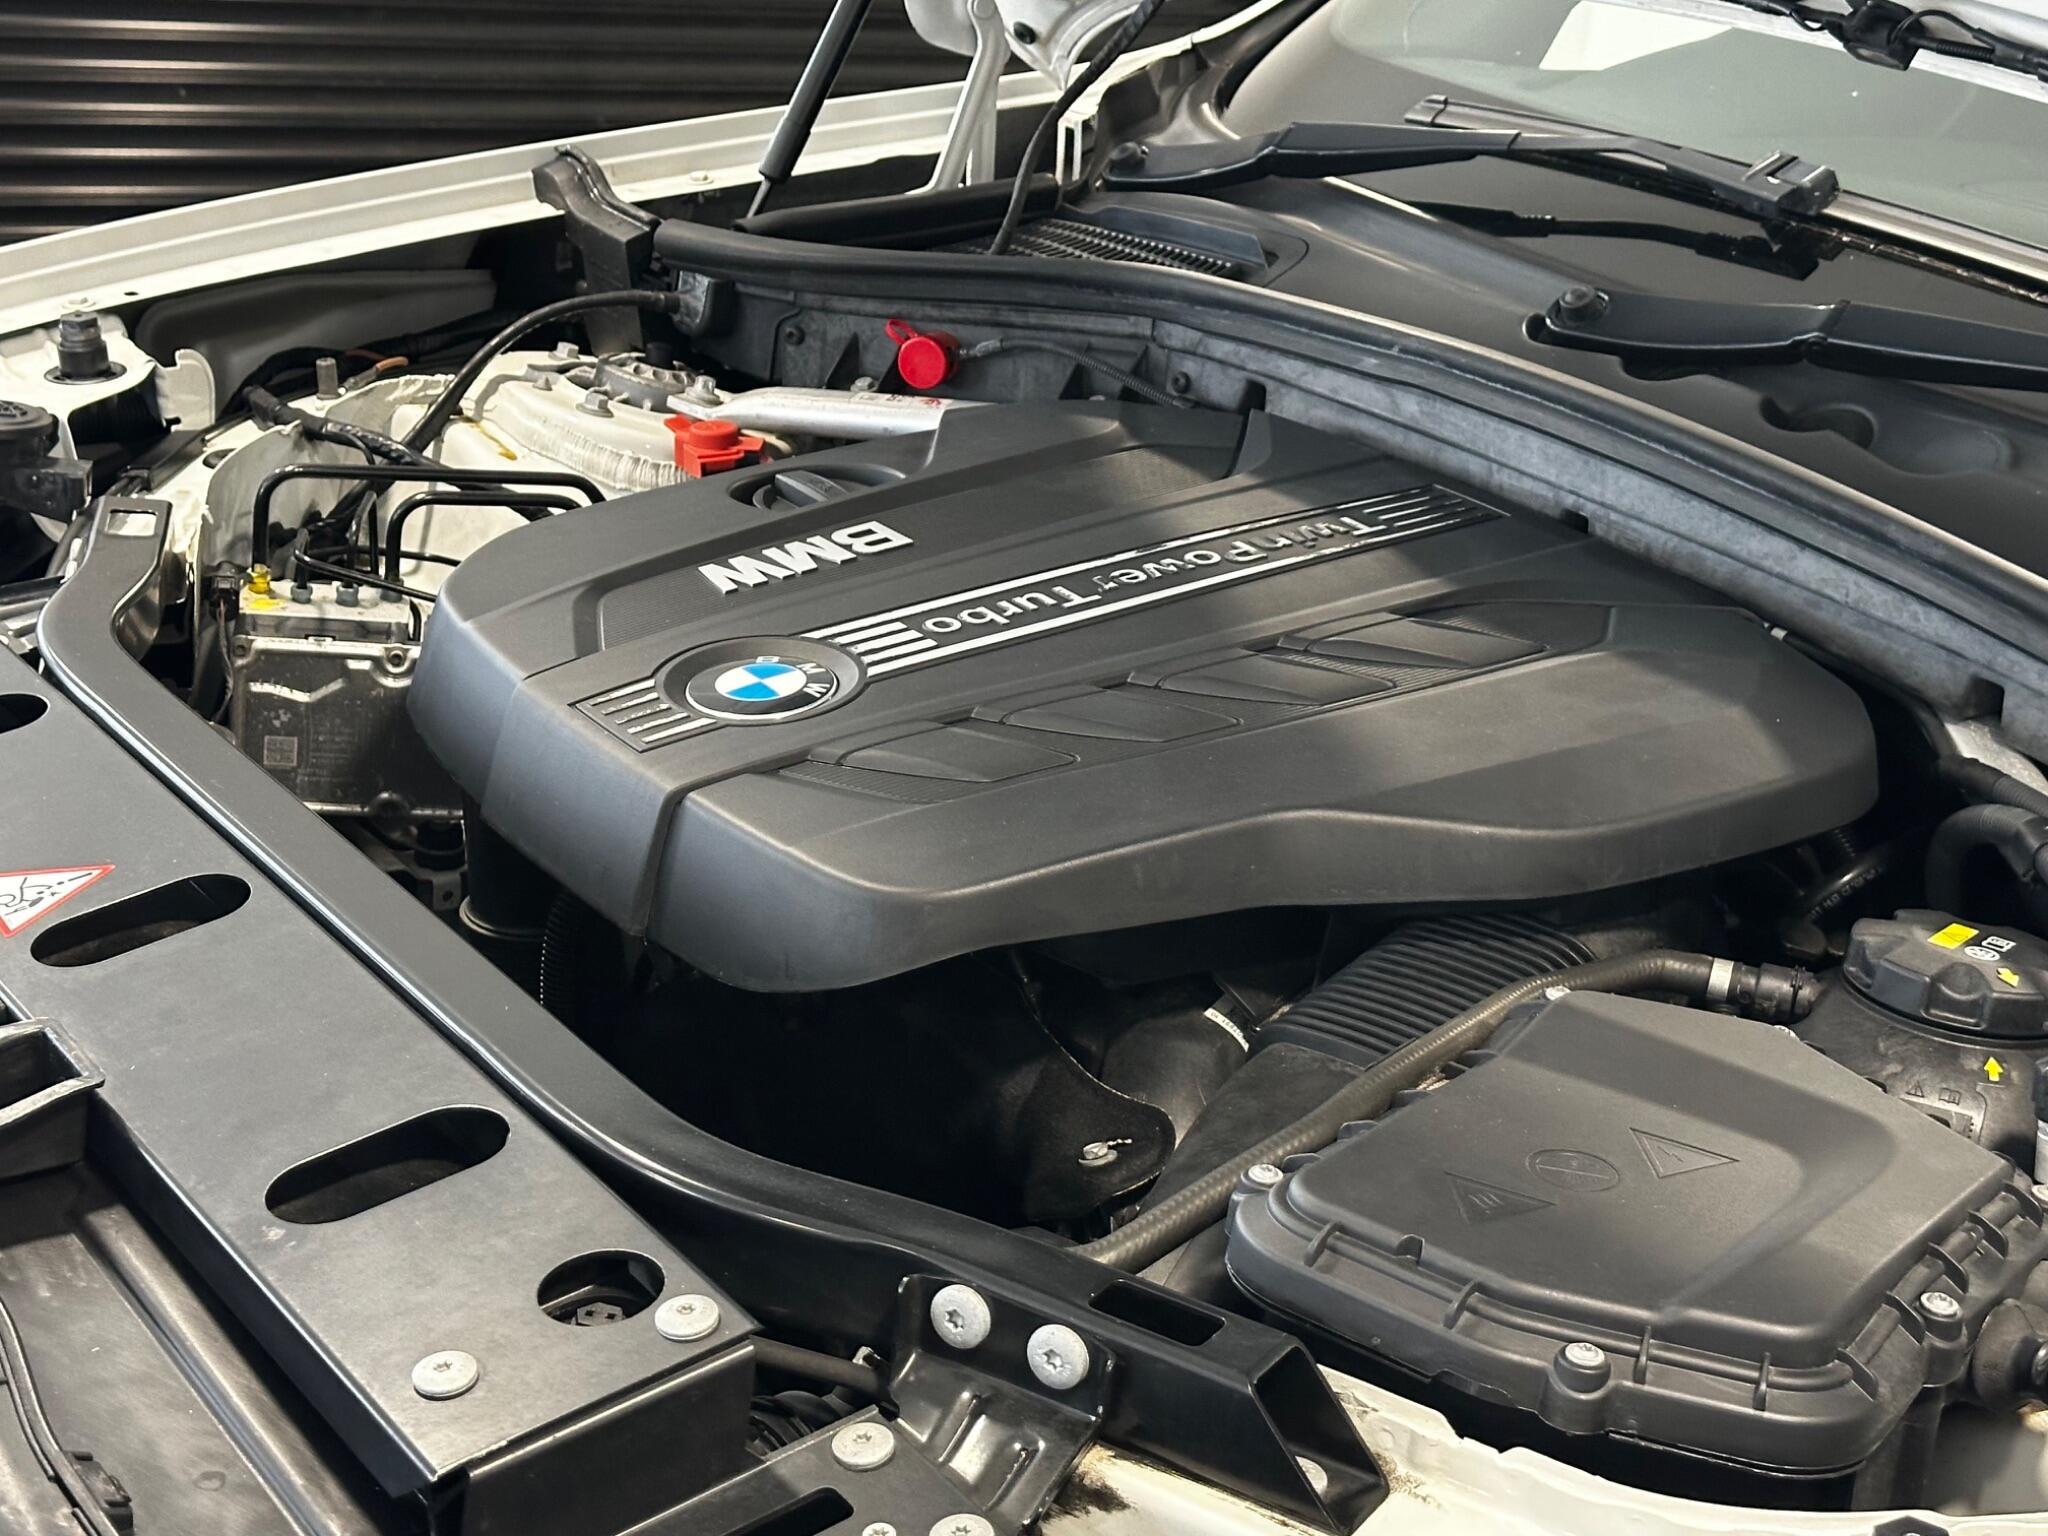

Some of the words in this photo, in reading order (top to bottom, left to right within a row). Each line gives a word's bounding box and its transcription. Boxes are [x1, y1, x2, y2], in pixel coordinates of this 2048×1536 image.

[697, 520, 914, 596] BMW
[1092, 515, 1387, 593] TwinPower
[922, 585, 1102, 634] Turbo
[755, 656, 831, 698] BMW
